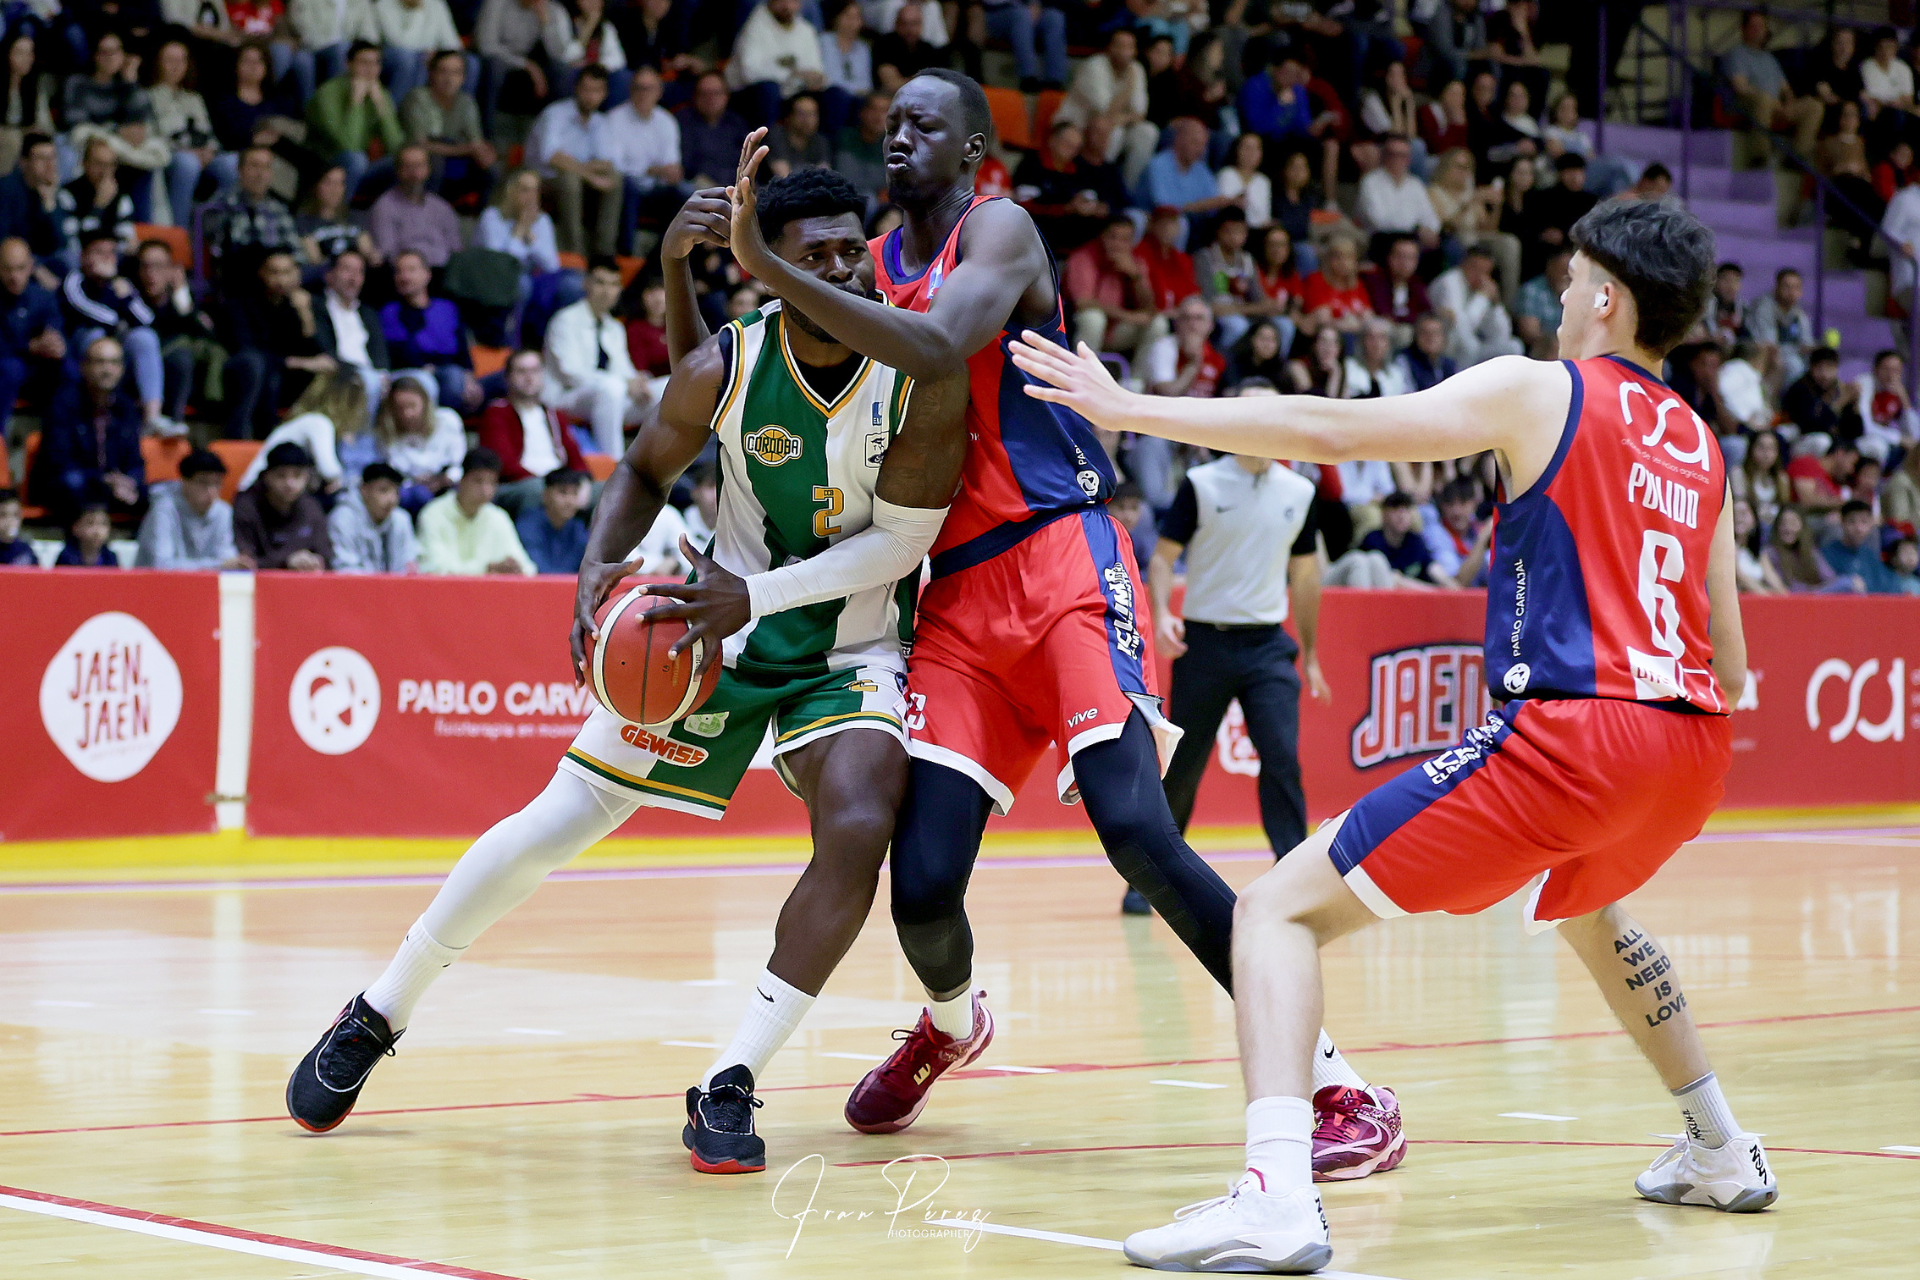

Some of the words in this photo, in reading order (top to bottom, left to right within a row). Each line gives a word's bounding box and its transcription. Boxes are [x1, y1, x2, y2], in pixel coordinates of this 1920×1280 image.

[813, 485, 845, 538] 2
[1628, 462, 1699, 530] PULIDO
[1514, 558, 1526, 617] CARVAJAL
[1638, 529, 1685, 660] 6
[1511, 619, 1522, 657] PABLO
[398, 679, 498, 716] PABLO
[503, 681, 597, 716] CARV
[1353, 644, 1492, 766] JAEN
[1067, 707, 1098, 728] vive
[1614, 929, 1643, 954] ALL
[1623, 941, 1656, 967] WE
[1625, 955, 1671, 991] NEED
[1654, 981, 1672, 1001] IS
[1645, 992, 1687, 1027] LOVE
